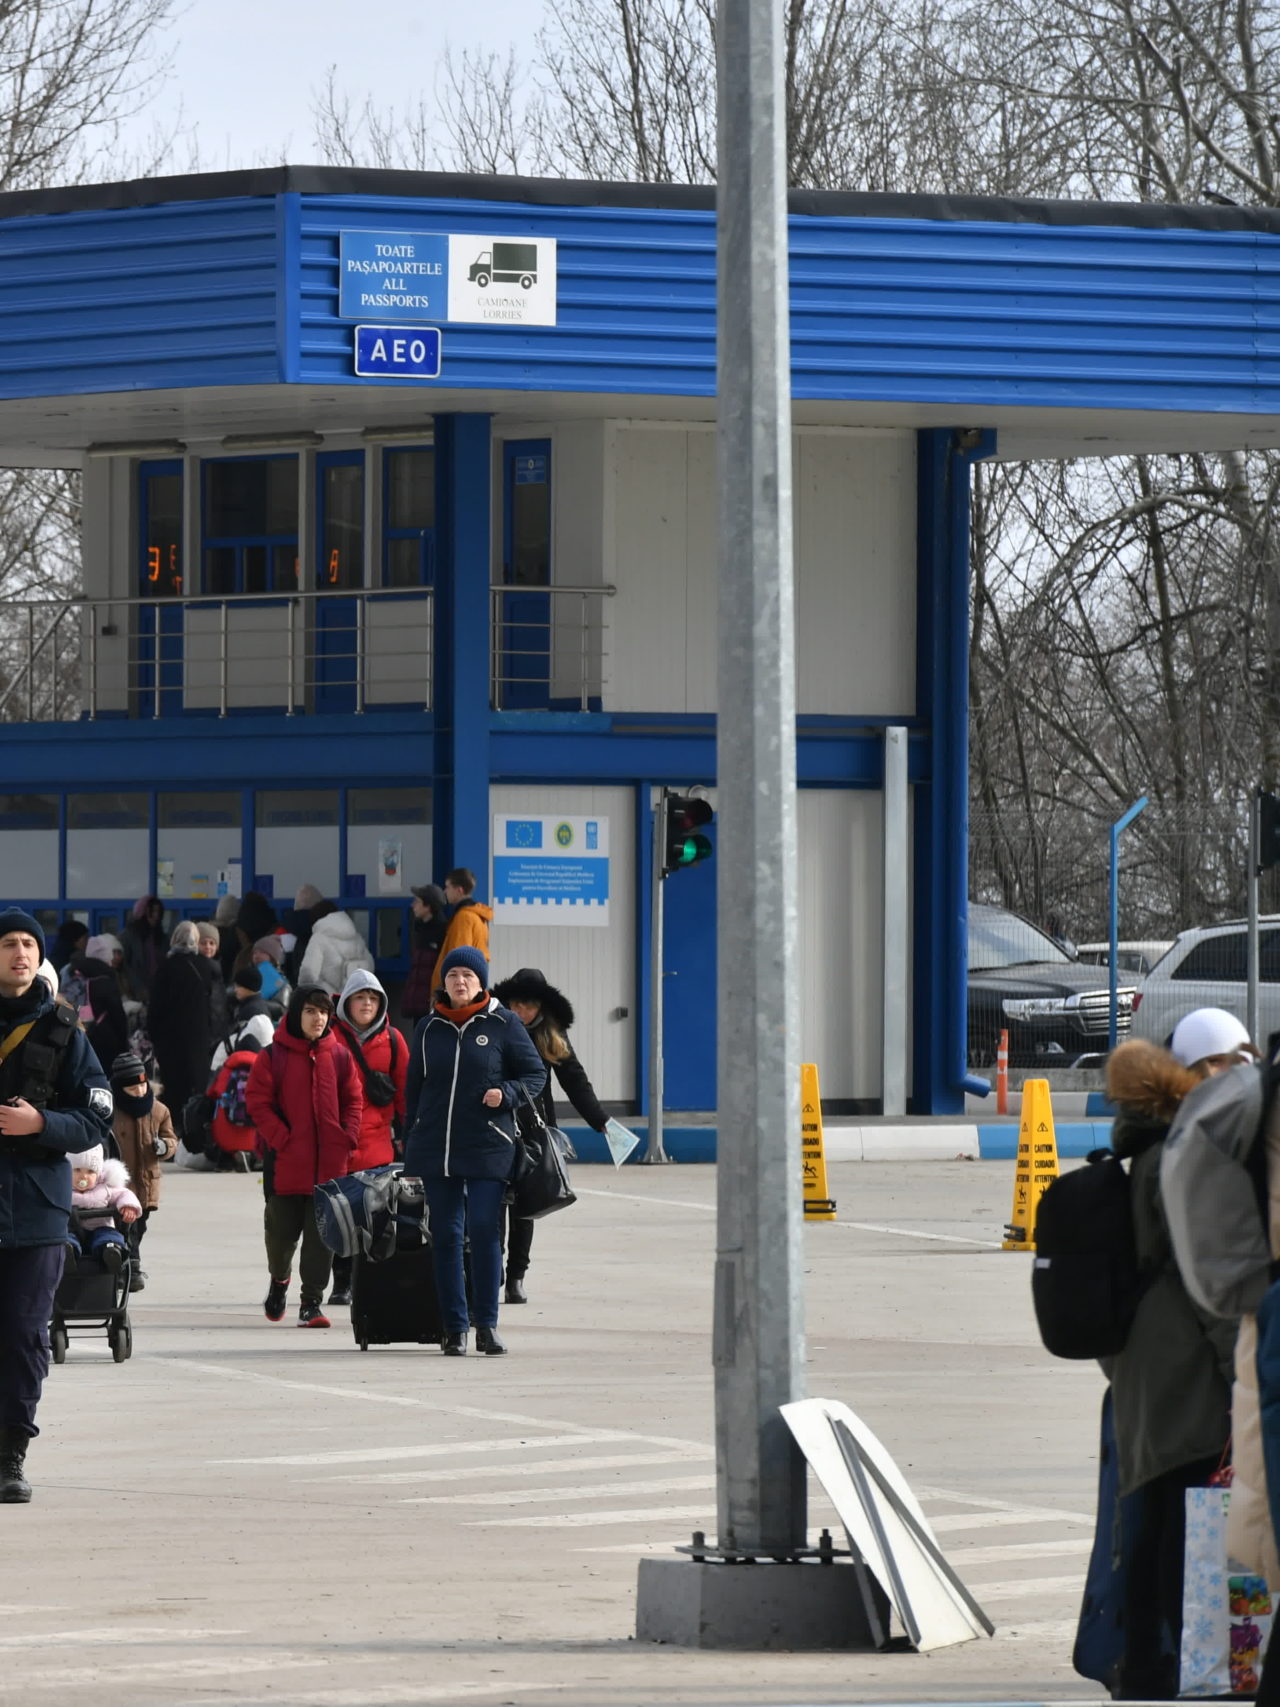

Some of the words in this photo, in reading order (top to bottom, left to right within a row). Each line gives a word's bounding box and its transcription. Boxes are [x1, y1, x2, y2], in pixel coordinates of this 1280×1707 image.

[375, 244, 415, 258] TOATE
[382, 278, 407, 291] ALL
[361, 293, 429, 308] PASSPORTS
[477, 297, 527, 308] CAMIOANE
[483, 309, 522, 320] LORRIES
[371, 338, 426, 363] AEO
[802, 1123, 818, 1132] AUTION
[1034, 1144, 1053, 1153] CAUTION
[1034, 1160, 1055, 1168] CUIDADO
